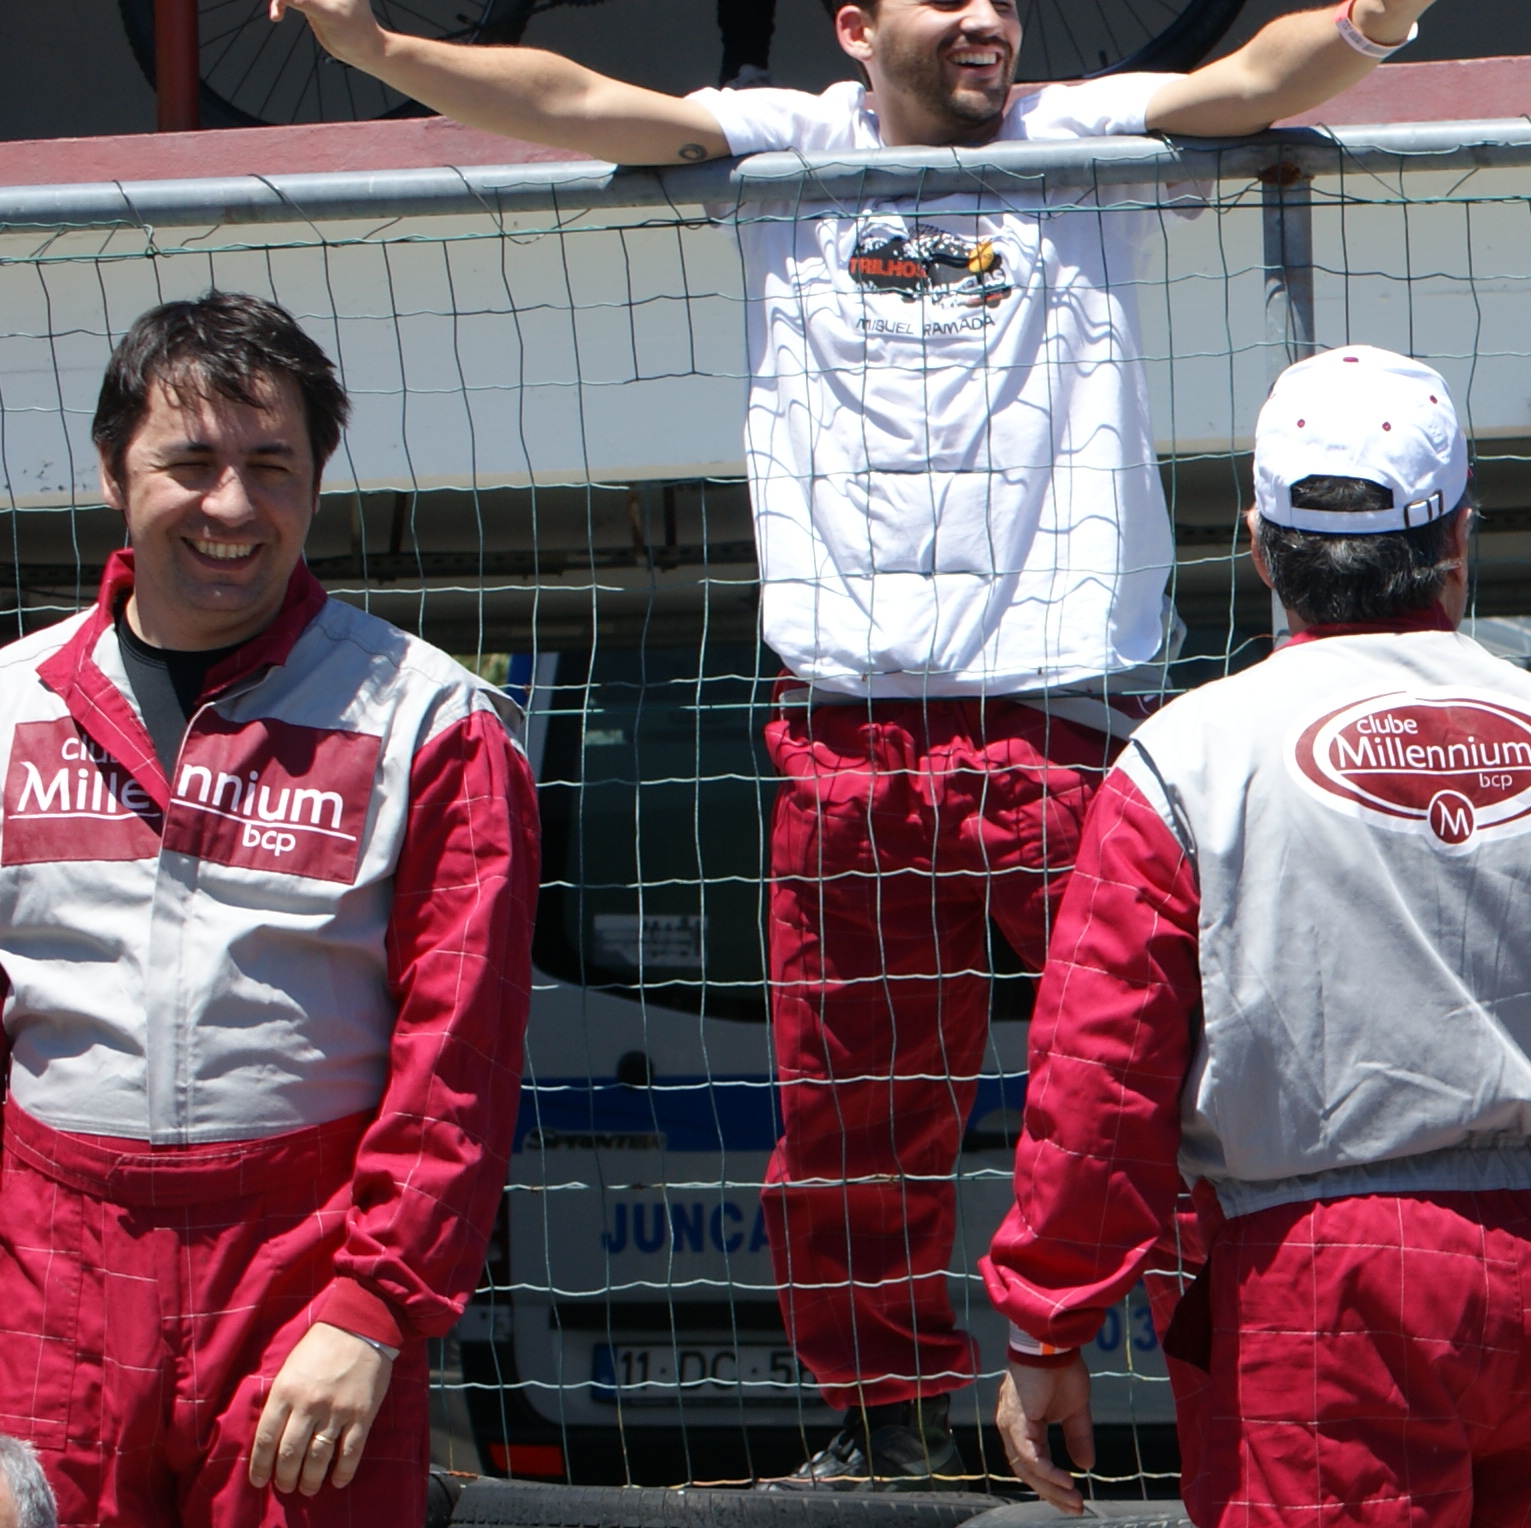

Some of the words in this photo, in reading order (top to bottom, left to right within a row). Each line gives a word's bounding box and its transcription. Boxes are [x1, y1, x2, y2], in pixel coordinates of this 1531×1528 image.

[1356, 713, 1419, 735] clube
[1479, 771, 1513, 791] bcp
[242, 822, 297, 857] bcp
